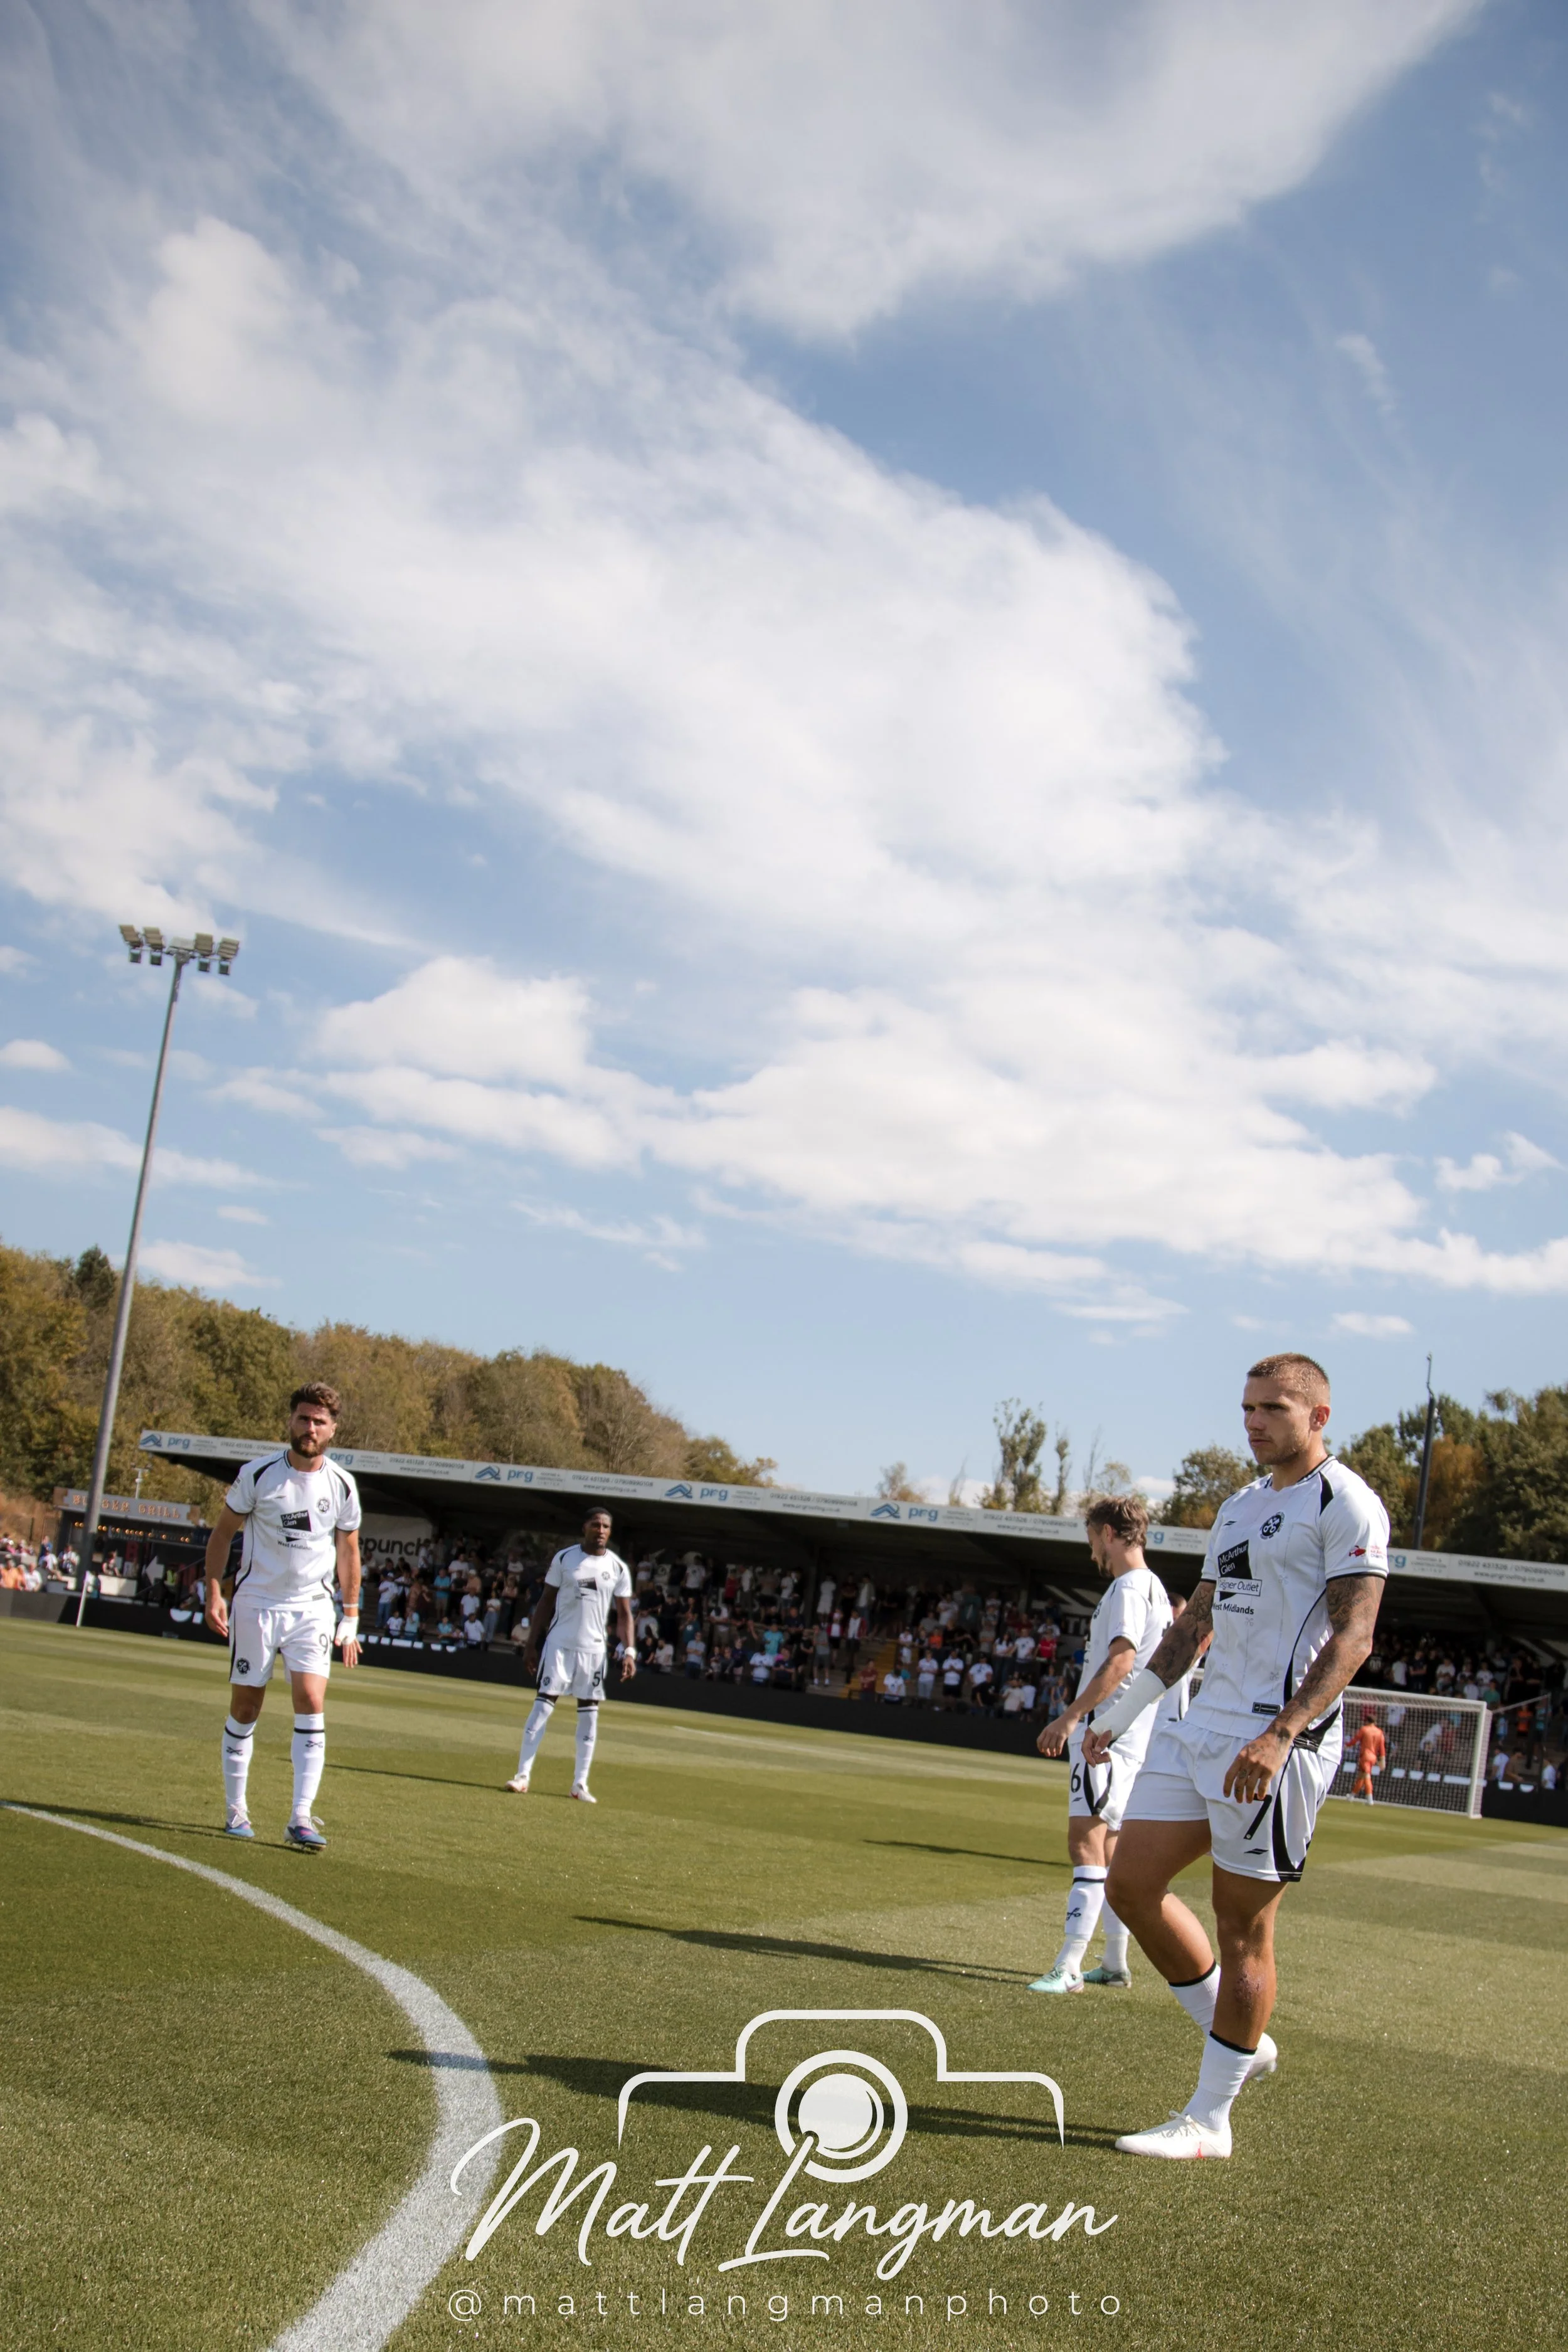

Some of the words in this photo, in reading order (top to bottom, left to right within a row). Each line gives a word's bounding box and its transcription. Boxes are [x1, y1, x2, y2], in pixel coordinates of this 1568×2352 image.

[168, 1436, 191, 1449] prg
[507, 1468, 534, 1482] prg
[700, 1486, 728, 1501] prg
[282, 1512, 308, 1520] McArthur
[908, 1507, 938, 1522] prg
[1219, 1544, 1248, 1565] McArthur
[1221, 1562, 1236, 1575] Glen
[1237, 1581, 1259, 1592] Outlet
[1223, 1602, 1254, 1615] Midlands
[319, 1633, 329, 1656] 9
[592, 1671, 601, 1687] 5
[1071, 1763, 1081, 1793] 6
[1243, 1793, 1273, 1840] 7
